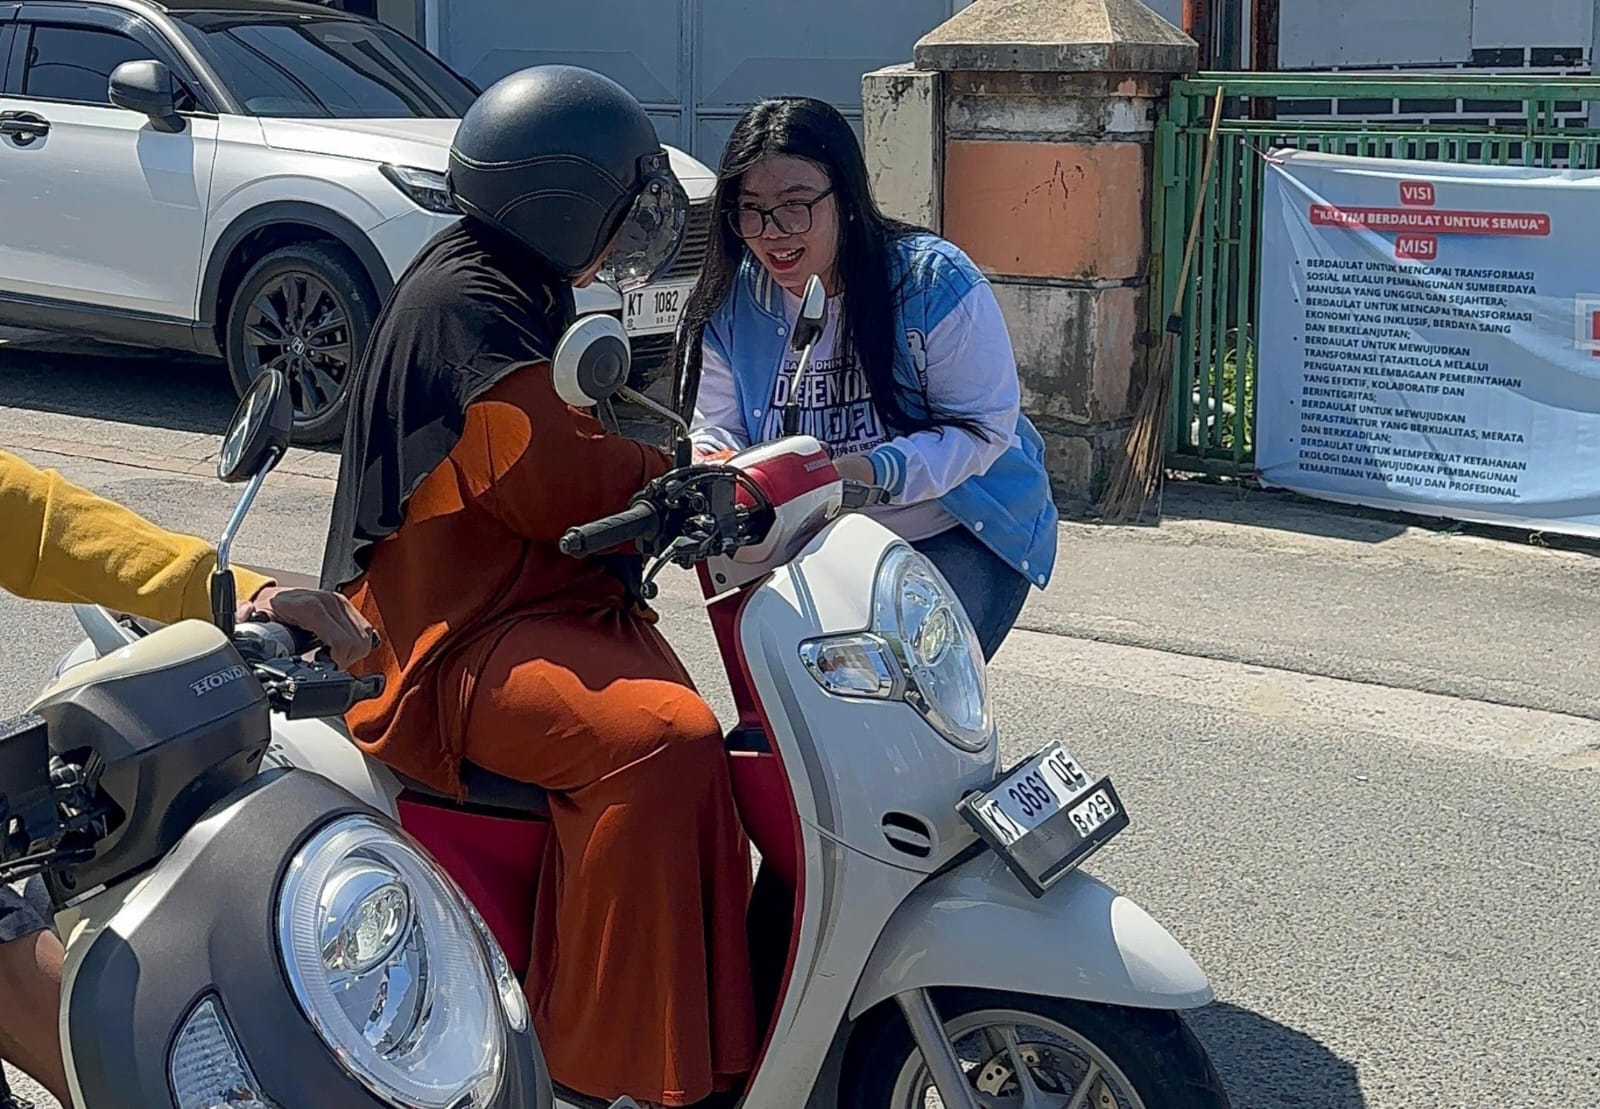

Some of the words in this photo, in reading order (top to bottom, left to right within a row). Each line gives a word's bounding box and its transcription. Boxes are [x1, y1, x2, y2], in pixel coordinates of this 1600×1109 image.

[1402, 186, 1432, 200] VISI
[1367, 213, 1441, 226] BERDAULAT
[1443, 215, 1489, 229] UNTUK
[1491, 218, 1545, 230] SEMUA"
[1399, 239, 1433, 254] MISI
[1306, 259, 1363, 271] BERDAULAT
[1365, 262, 1397, 273] UNTUK
[1399, 265, 1452, 277] MENCAPAI
[1454, 268, 1534, 280] TRANSFORMASI
[1306, 272, 1339, 282] SOSIAL
[1342, 274, 1384, 284] MELALUI
[1386, 276, 1463, 291] PEMBANGUNAN
[1465, 282, 1536, 294] SUMBERDAYA
[628, 293, 643, 316] KT
[654, 290, 679, 314] 1082
[1306, 285, 1351, 295] MANUSIA
[1353, 287, 1381, 297] YANG
[1383, 289, 1425, 300] UNGGUL
[1426, 292, 1446, 302] DAN
[1449, 295, 1507, 307] SEJAHTERA;
[1305, 298, 1361, 309] BERDAULAT
[1363, 301, 1399, 312] UNTUK
[1400, 304, 1450, 315] MENCAPAI
[1452, 308, 1532, 321] TRANSFORMASI
[1305, 310, 1350, 321] EKONOMI
[1353, 313, 1381, 323] YANG
[1383, 315, 1431, 328] INKLUSIF,
[1433, 319, 1477, 331] BERDAYA
[1479, 323, 1511, 334] SAING
[1305, 323, 1325, 332] DAN
[1328, 325, 1411, 340] BERKELANJUTAN;
[1304, 335, 1358, 347] BERDAULAT
[1361, 340, 1396, 351] UNTUK
[1398, 342, 1470, 356] MEWUJUDKAN
[1304, 348, 1376, 362] TRANSFORMASI
[1379, 354, 1441, 368] TATAKELOLA
[1444, 359, 1488, 372] MELALUI
[1303, 361, 1360, 374] PENGUATAN
[1363, 366, 1436, 380] KELEMBAGAAN
[1439, 372, 1521, 388] PEMERINTAHAN
[1303, 374, 1330, 384] YANG
[1332, 377, 1369, 389] EFEKTIF,
[1371, 380, 1440, 394] KOLABORATIF
[1442, 386, 1465, 396] DAN
[1302, 386, 1376, 403] BERINTEGRITAS;
[1301, 399, 1357, 413] BERDAULAT
[1359, 405, 1393, 416] UNTUK
[1395, 408, 1466, 423] MEWUJUDKAN
[1301, 412, 1377, 428] INFRASTRUKTUR
[1380, 420, 1408, 431] YANG
[1410, 423, 1479, 440] BERKUALITAS,
[1481, 430, 1524, 443] MERATA
[1301, 424, 1320, 434] DAN
[1323, 427, 1392, 443] BERKEADILAN;
[1300, 437, 1353, 451] BERDAULAT
[1355, 444, 1391, 455] UNTUK
[1393, 448, 1461, 463] MEMPERKUAT
[1463, 455, 1527, 470] KETAHANAN
[1299, 450, 1339, 462] EKOLOGI
[1341, 455, 1361, 465] DAN
[1364, 458, 1434, 473] MEWUJUDKAN
[1437, 466, 1518, 483] PEMBANGUNAN
[1298, 462, 1363, 478] KEMARITIMAN
[1365, 470, 1393, 482] YANG
[1395, 475, 1422, 486] MAJU
[1424, 478, 1446, 489] DAN
[1449, 481, 1521, 498] PROFESIONAL.
[983, 799, 1021, 842] KT
[1008, 770, 1060, 817] 3661
